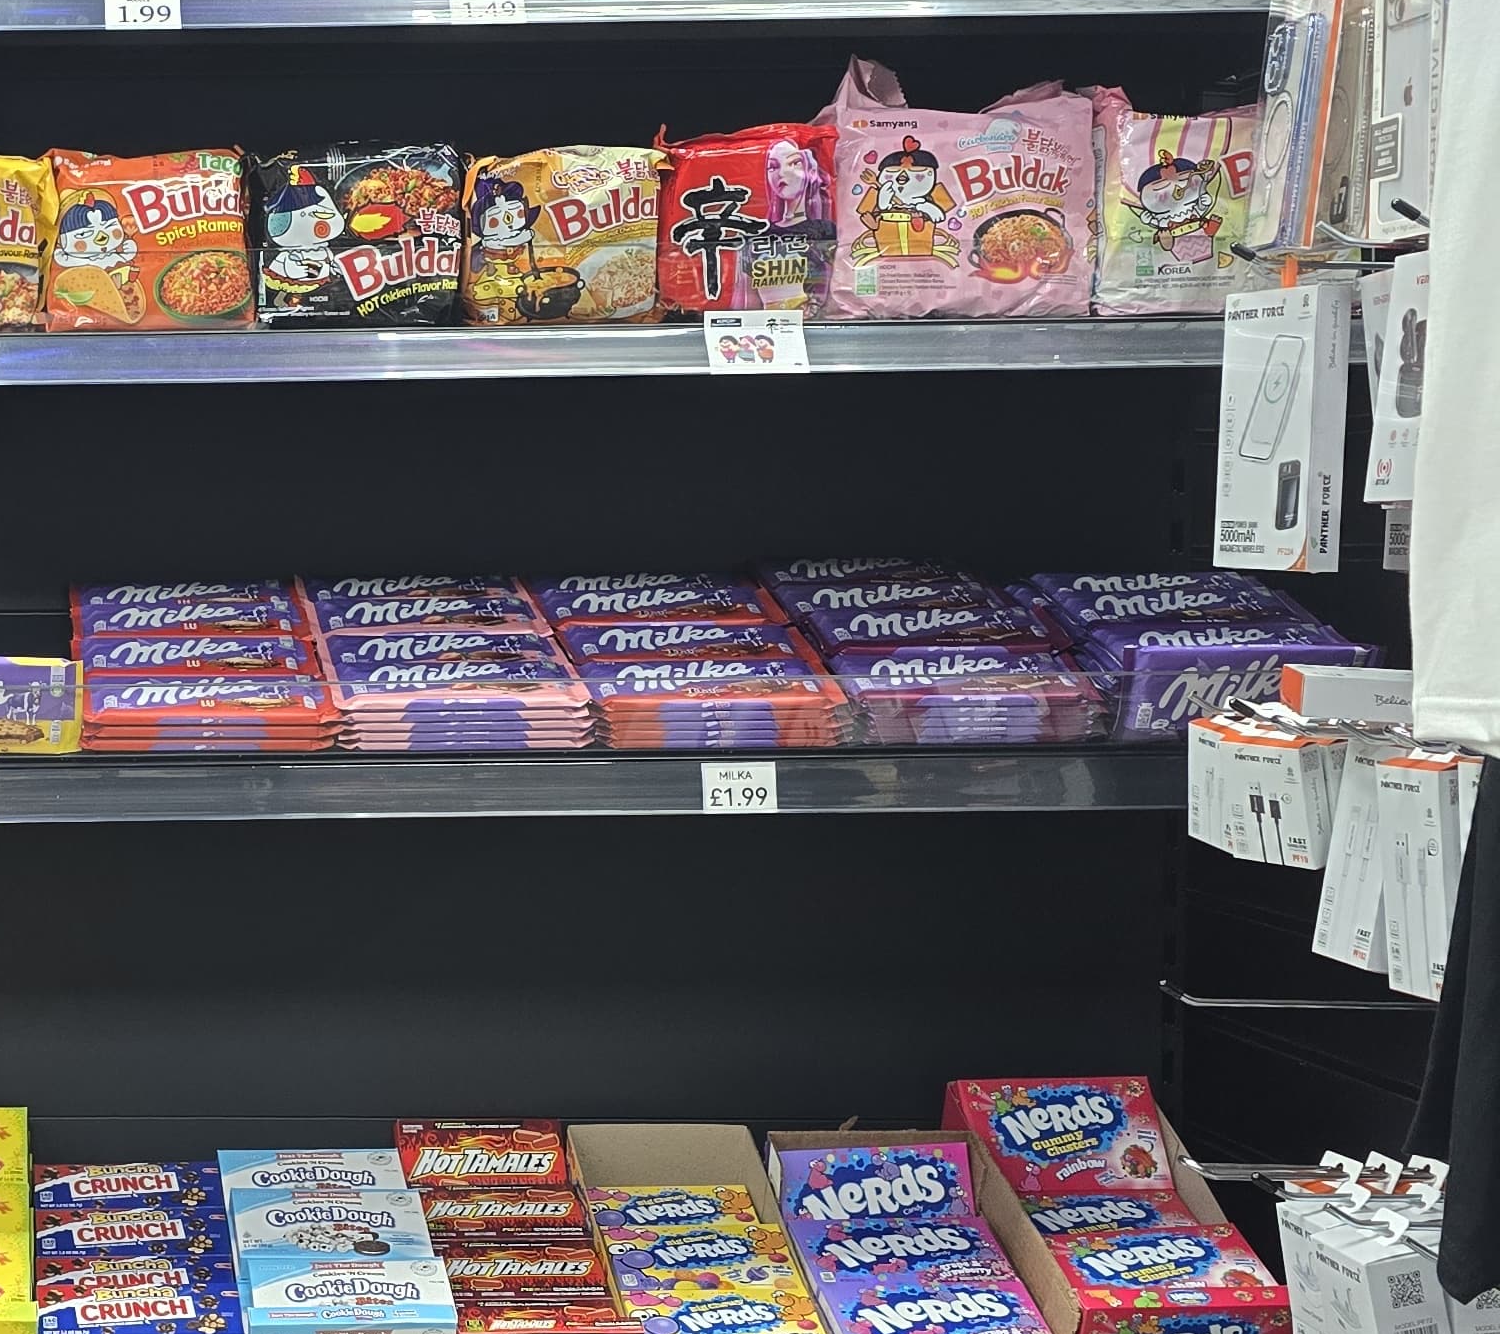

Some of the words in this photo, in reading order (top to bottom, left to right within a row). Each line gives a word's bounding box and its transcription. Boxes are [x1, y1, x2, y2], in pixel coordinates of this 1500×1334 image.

[118, 6, 172, 22] 1.99
[156, 222, 195, 244] Spicy
[674, 179, 767, 301] 辛
[752, 259, 806, 278] SHIN
[751, 275, 804, 287] RAMYUN
[1220, 530, 1256, 543] 5000mAh
[1096, 592, 1226, 620] Milka
[110, 640, 245, 664] Milka
[719, 771, 752, 780] MILKA
[710, 787, 767, 807] £1.99
[1032, 1131, 1083, 1151] Gummy
[1046, 1137, 1099, 1159] Clusters
[1056, 1156, 1106, 1180] rainbow
[76, 1220, 178, 1244] CRUNCH
